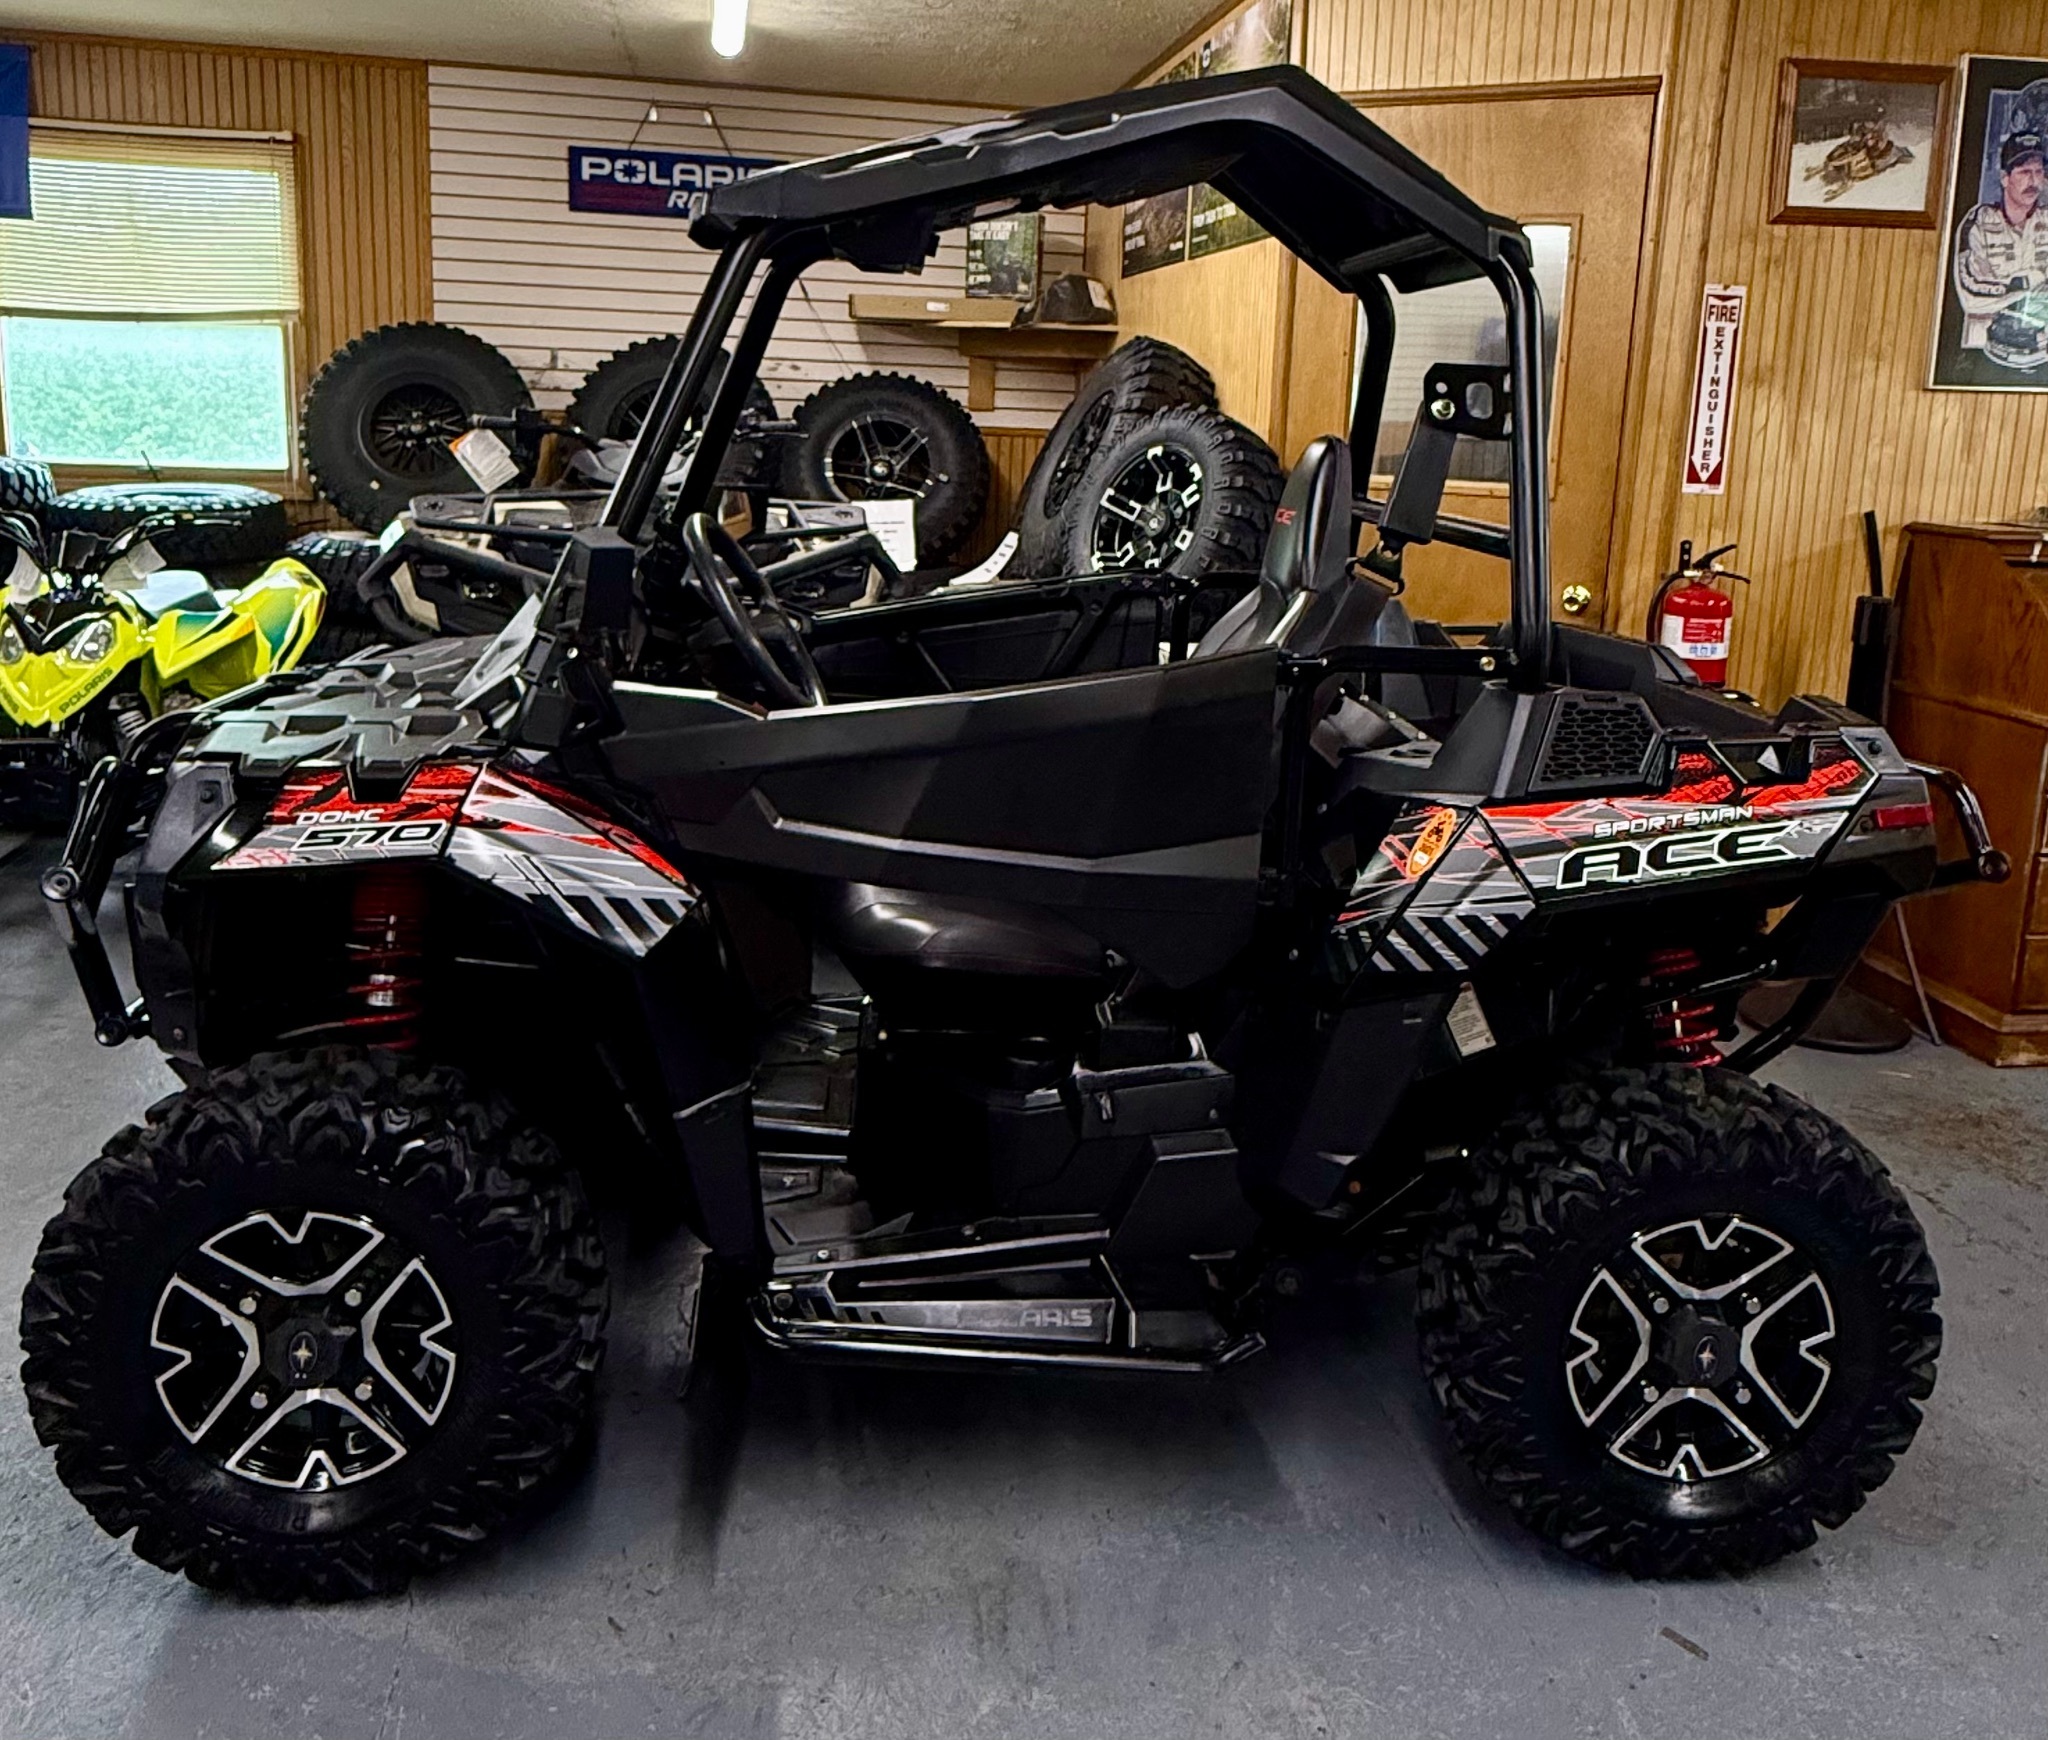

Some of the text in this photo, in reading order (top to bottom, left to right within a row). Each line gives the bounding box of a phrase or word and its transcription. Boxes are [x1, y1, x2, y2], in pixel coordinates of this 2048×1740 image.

[1708, 304, 1738, 322] FIRE
[1700, 326, 1726, 473] EXTINGUISHER
[59, 667, 113, 713] POLARIS
[296, 809, 384, 825] DOHC
[1594, 806, 1753, 838] SPORTSMAN
[292, 820, 447, 850] 570
[1556, 820, 1802, 890] ACE
